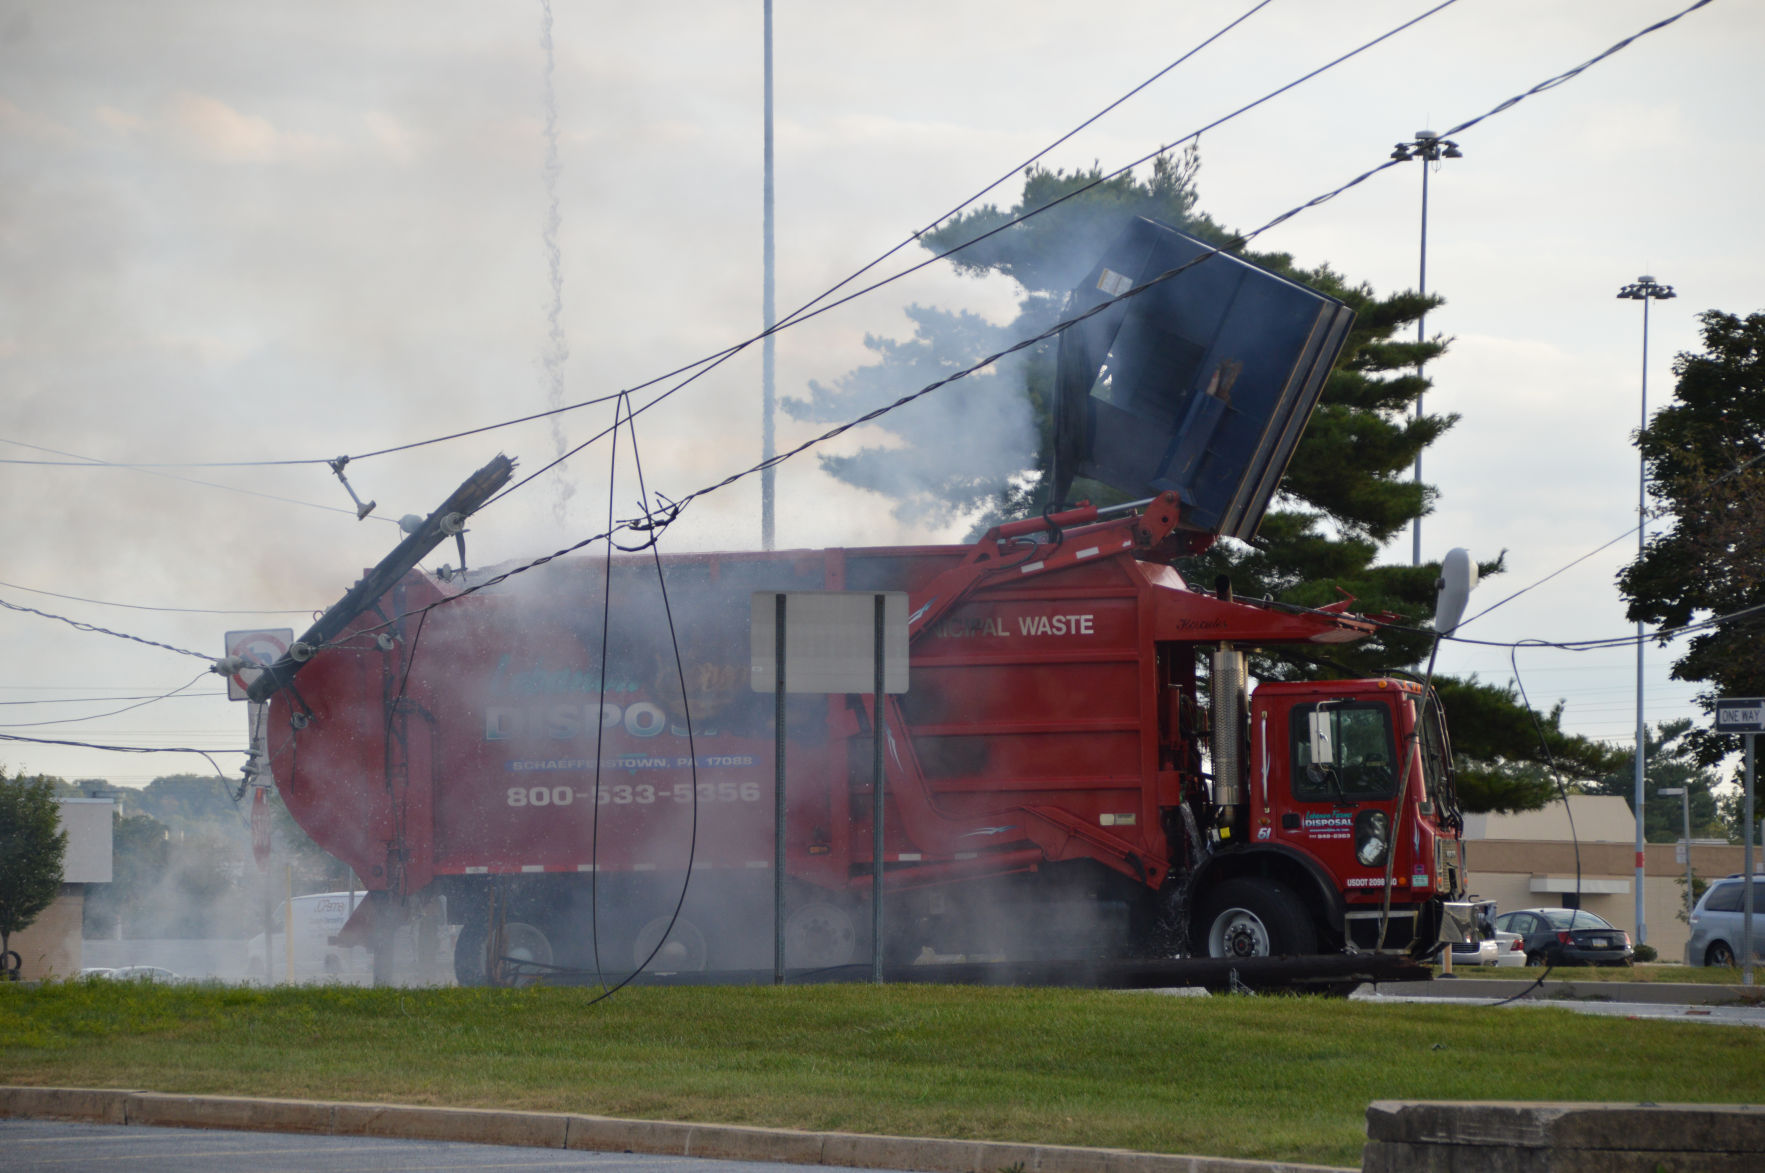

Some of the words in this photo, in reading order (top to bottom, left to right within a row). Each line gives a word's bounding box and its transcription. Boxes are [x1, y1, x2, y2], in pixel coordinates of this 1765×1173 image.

[1018, 614, 1095, 636] WASTE
[1722, 710, 1739, 722] ONE
[1741, 709, 1760, 722] WAY
[677, 757, 698, 767] PA
[507, 782, 761, 807] 800-533-5356
[1305, 818, 1353, 827] DISPOSAL
[1347, 878, 1368, 887] USDOT
